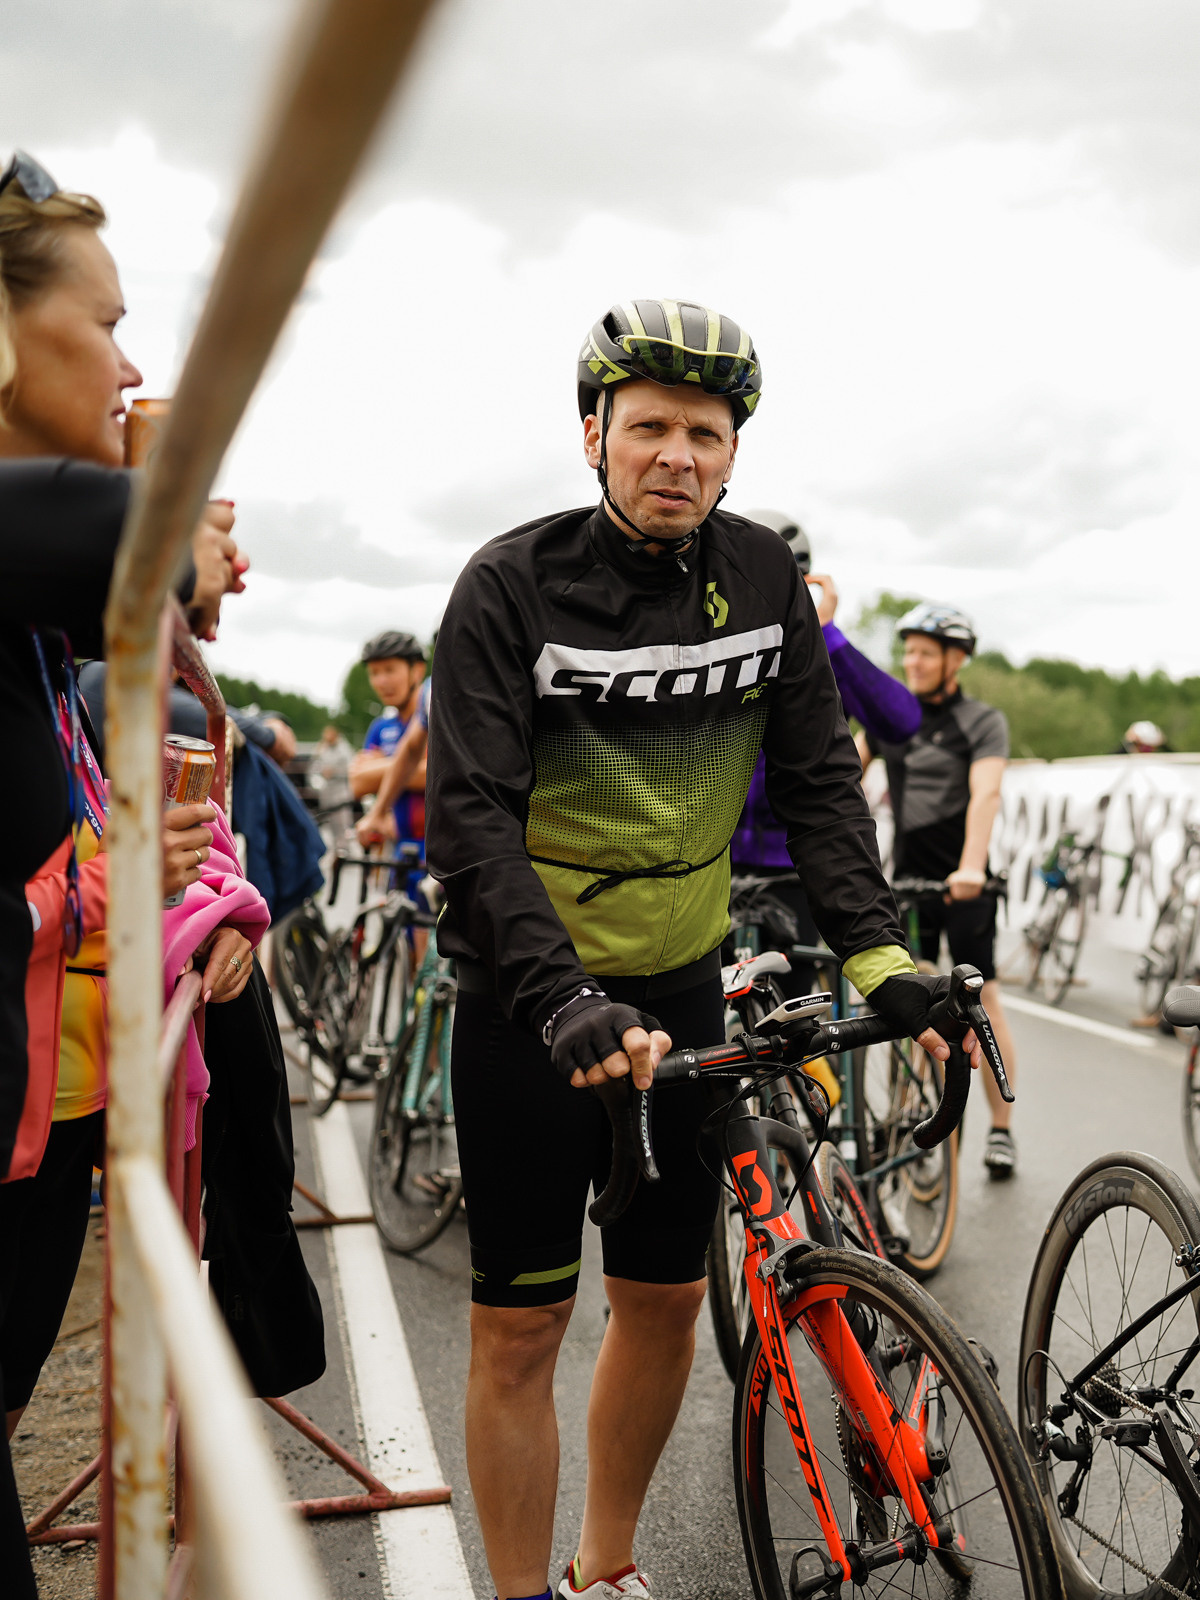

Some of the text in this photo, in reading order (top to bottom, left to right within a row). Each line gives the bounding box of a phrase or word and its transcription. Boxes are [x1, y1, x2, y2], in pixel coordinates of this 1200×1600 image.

[541, 646, 782, 702] SCOTT
[800, 997, 825, 1007] GARMIN
[982, 1024, 1006, 1081] ULTEGRA
[640, 1091, 651, 1158] ULTEGRA
